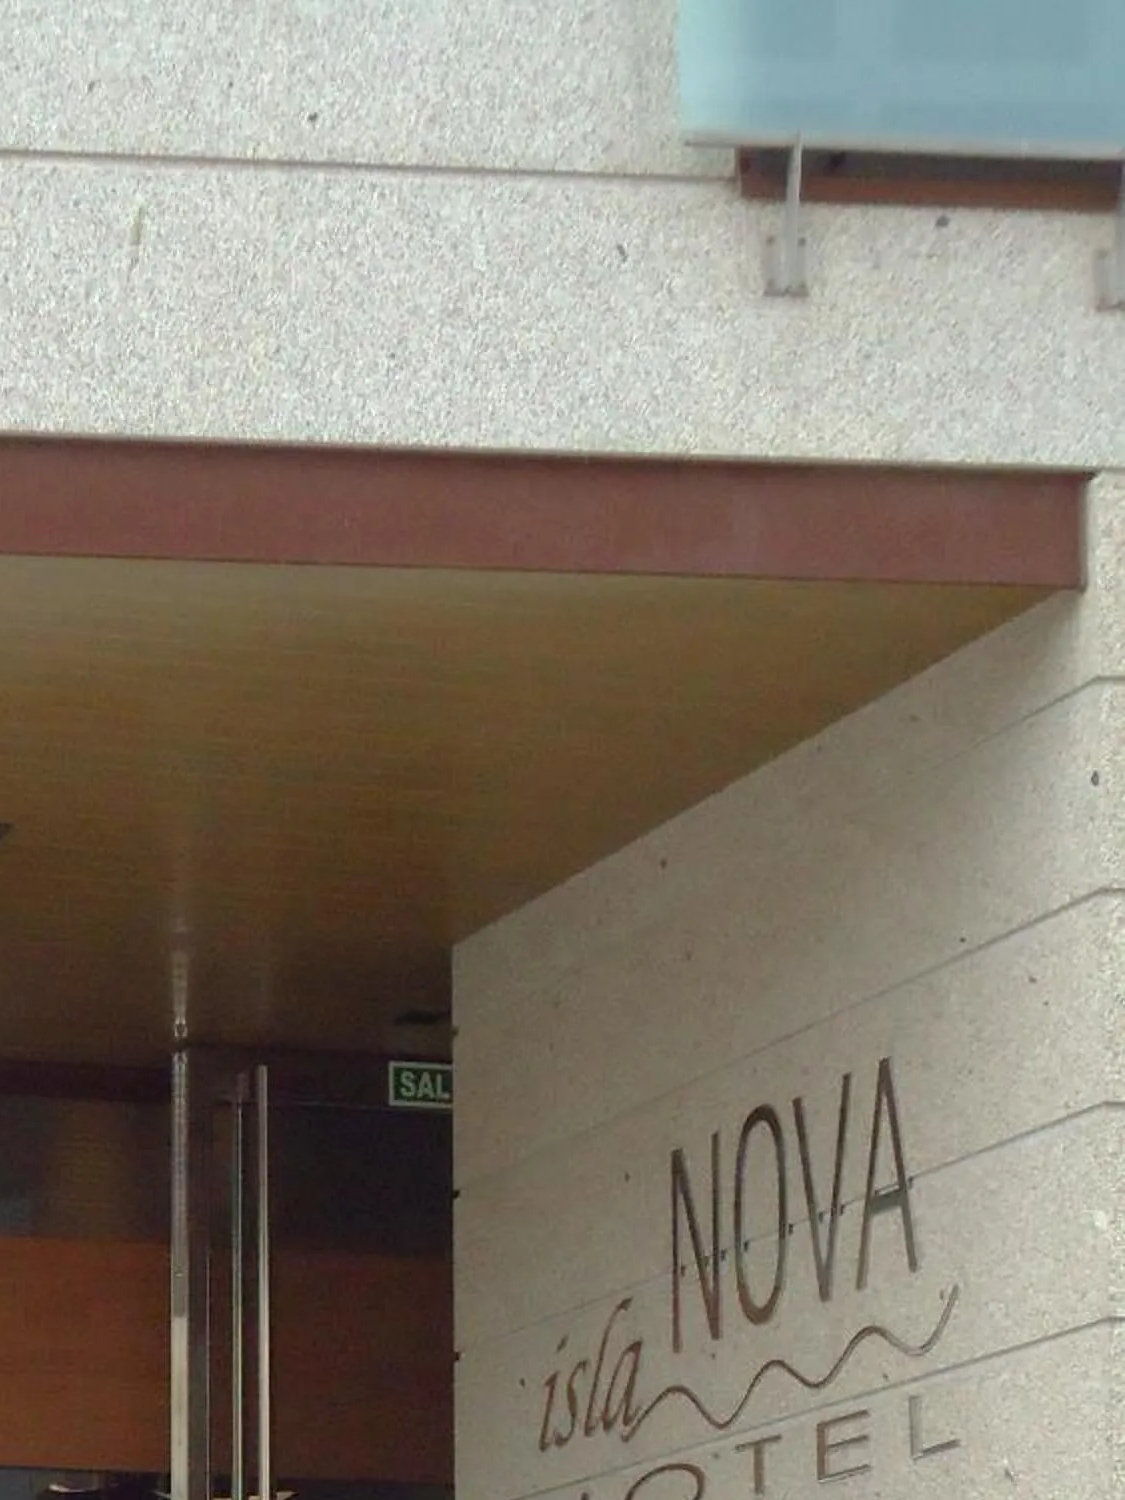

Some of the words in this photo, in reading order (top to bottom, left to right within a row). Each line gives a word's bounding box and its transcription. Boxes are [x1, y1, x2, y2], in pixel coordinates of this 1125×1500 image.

[400, 1070, 451, 1099] SAL
[538, 1297, 643, 1453] isla
[670, 1056, 918, 1354] NOVA
